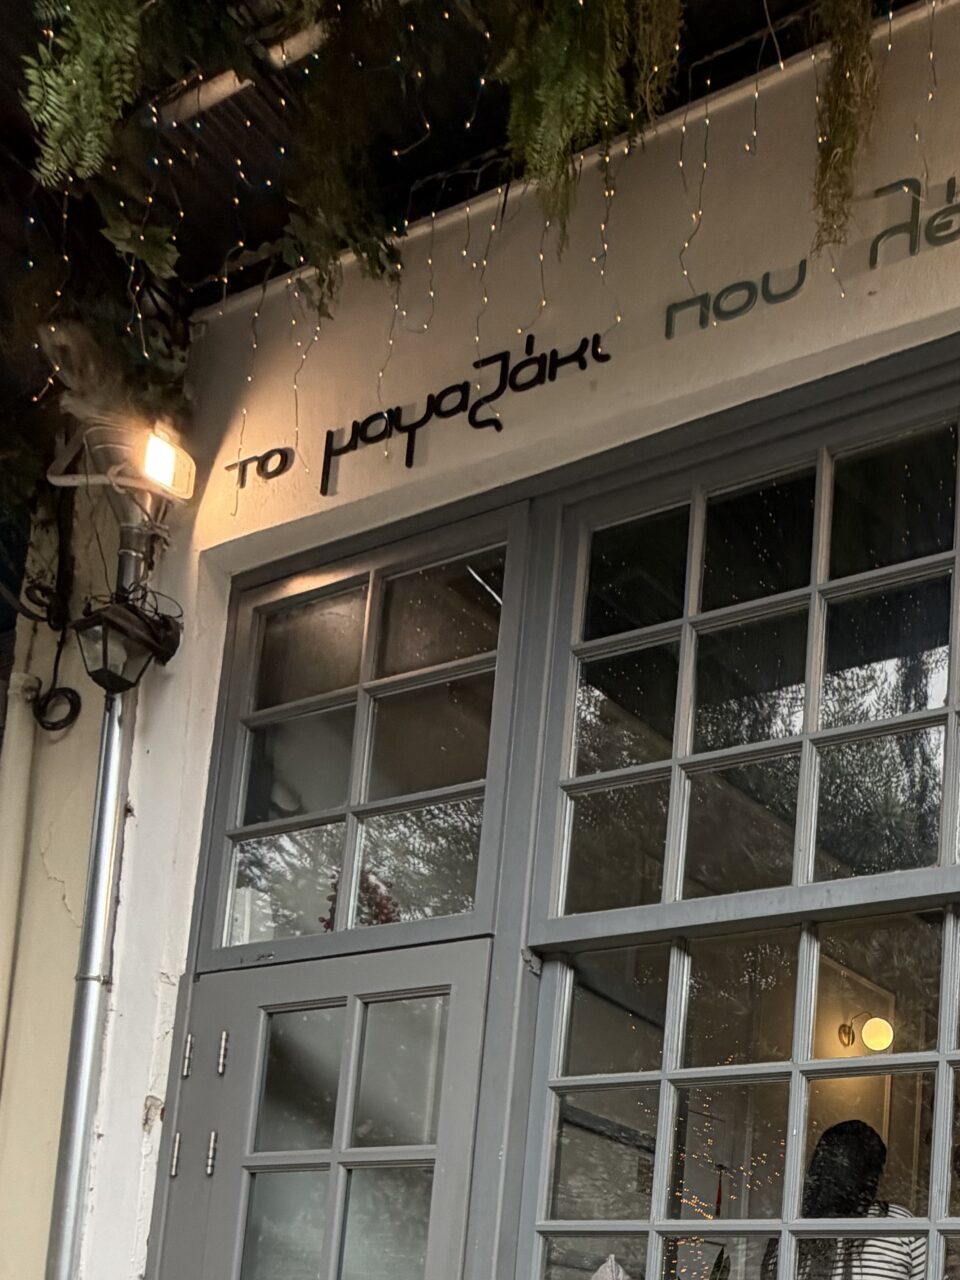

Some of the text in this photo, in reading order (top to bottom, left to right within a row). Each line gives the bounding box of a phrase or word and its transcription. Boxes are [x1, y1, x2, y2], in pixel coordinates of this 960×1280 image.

[225, 447, 288, 488] το
[320, 334, 611, 496] μαγαζάκι
[664, 259, 806, 338] που
